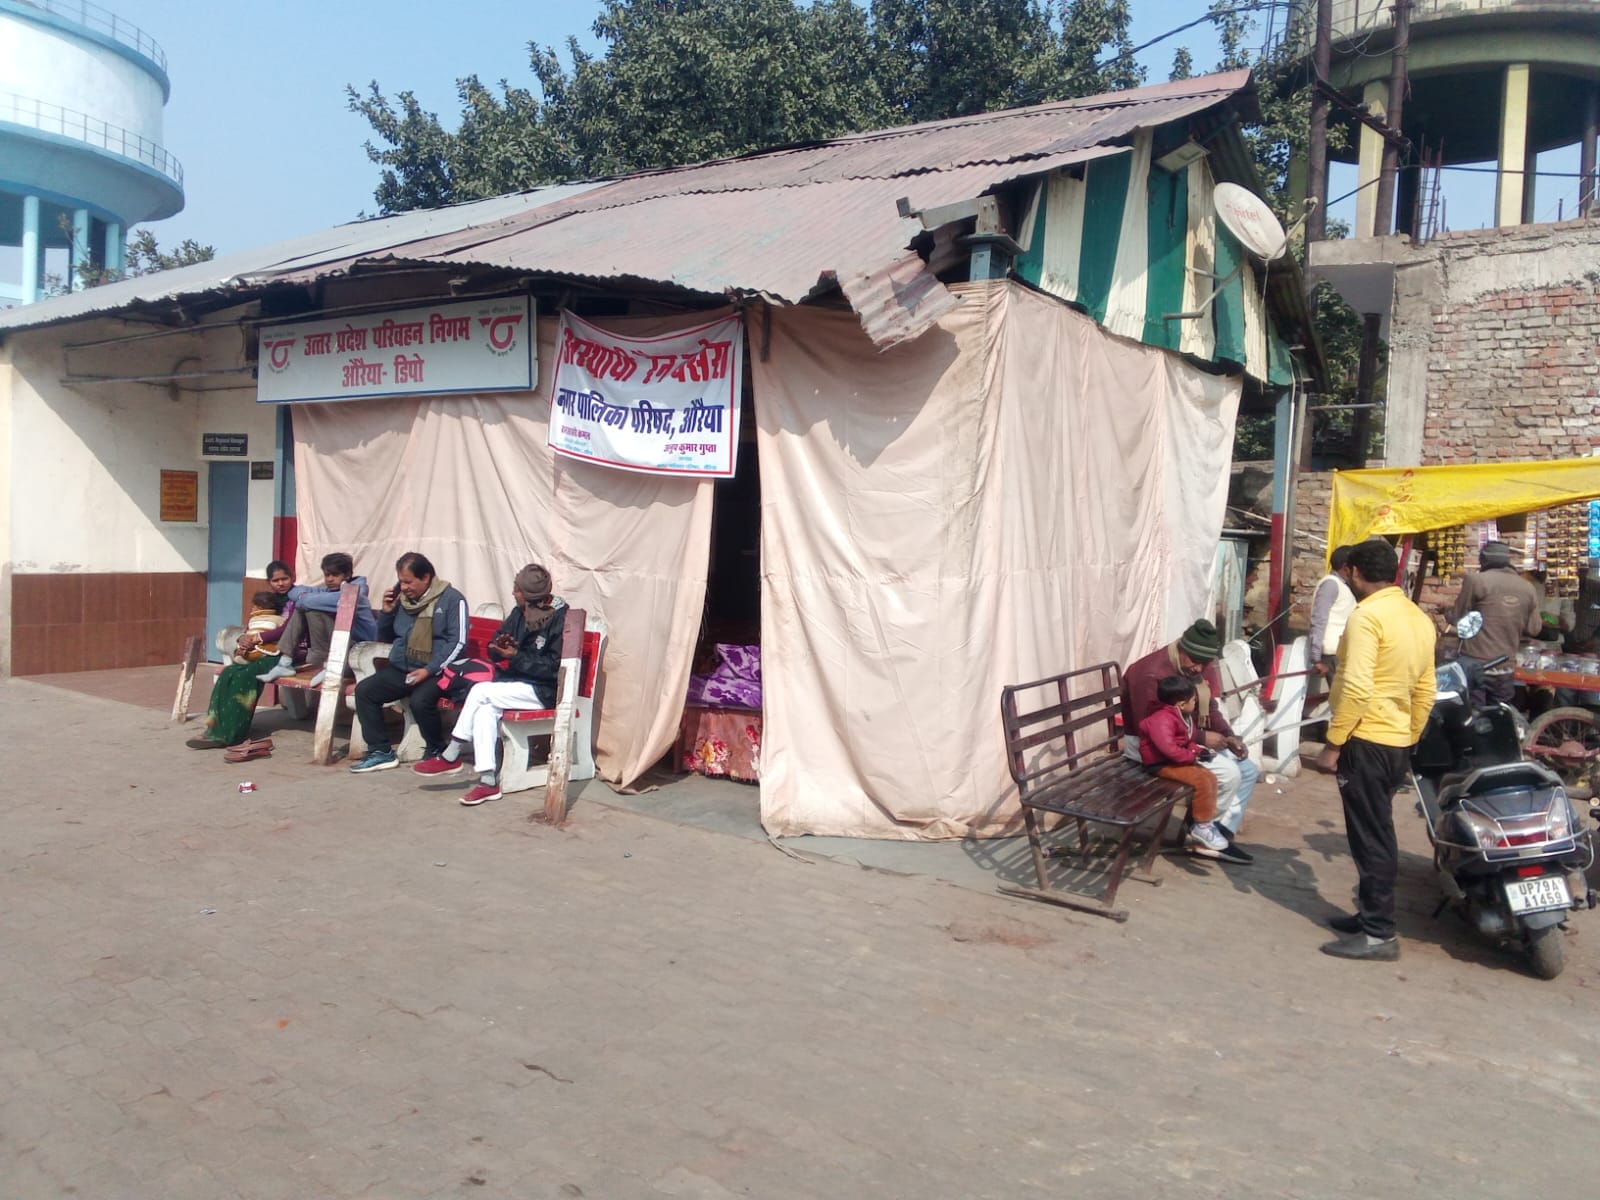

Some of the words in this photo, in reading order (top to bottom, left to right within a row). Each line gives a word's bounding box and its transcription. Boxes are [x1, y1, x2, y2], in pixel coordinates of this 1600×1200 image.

[304, 332, 332, 356] उत्तर
[335, 323, 368, 354] प्रदेश
[372, 318, 424, 348] परिवहन
[429, 313, 471, 343] निगम
[393, 353, 425, 384] डिपो
[577, 390, 630, 430] पालिका
[631, 400, 676, 440] परिषद,
[679, 397, 725, 433] औरैया
[678, 443, 698, 455] कुमार
[699, 443, 717, 456] गुप्ता
[1524, 891, 1563, 908] A1459
